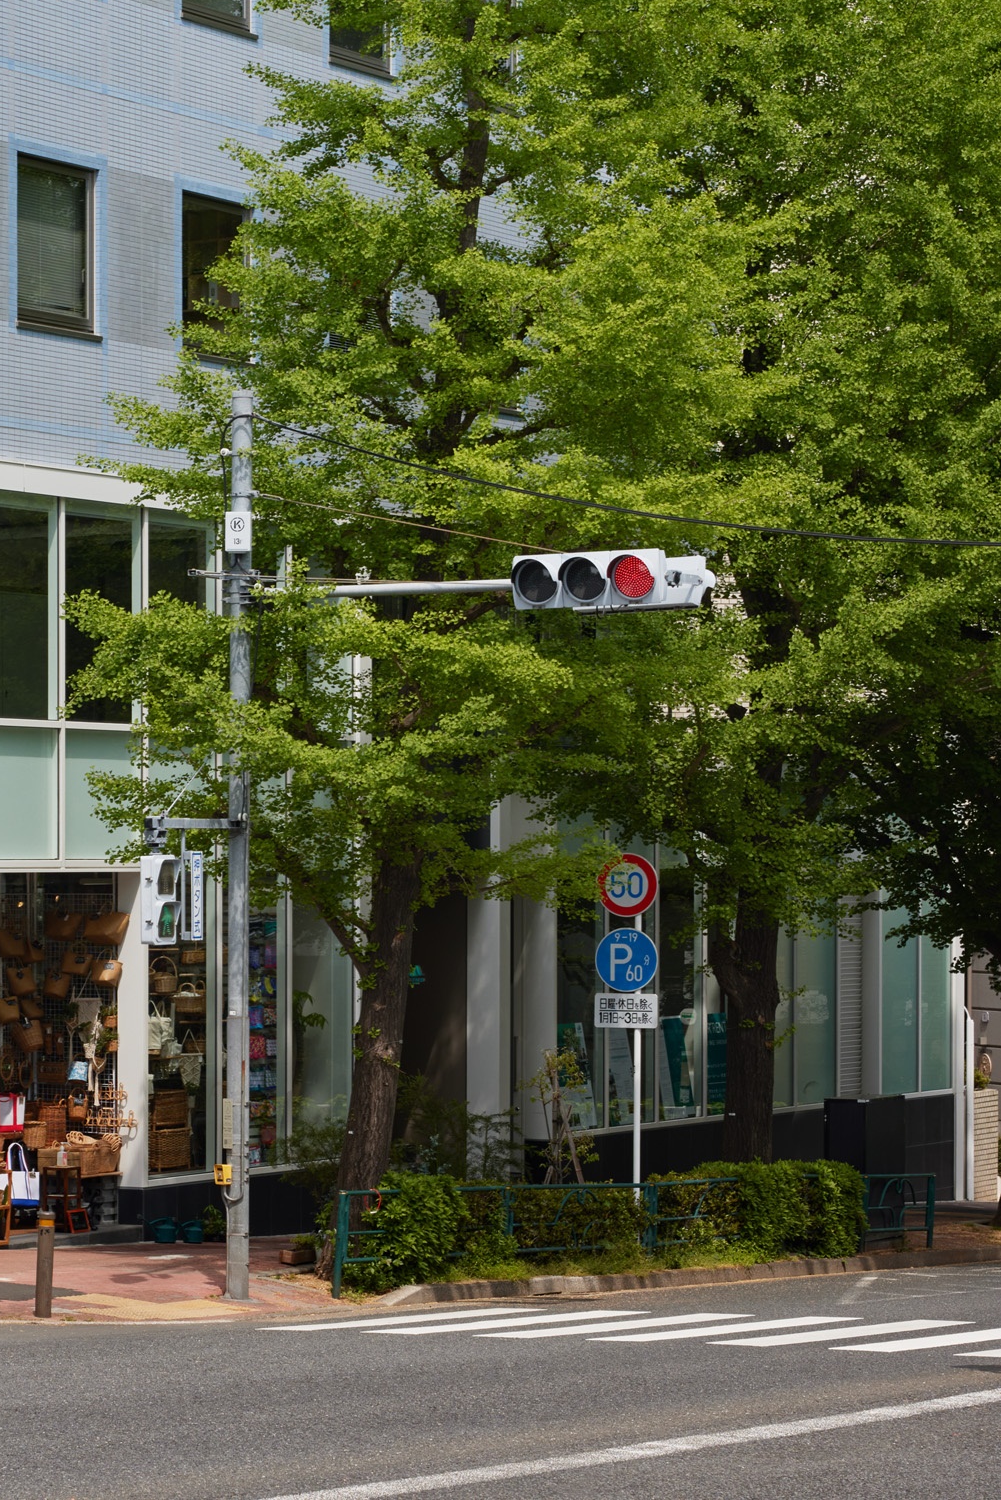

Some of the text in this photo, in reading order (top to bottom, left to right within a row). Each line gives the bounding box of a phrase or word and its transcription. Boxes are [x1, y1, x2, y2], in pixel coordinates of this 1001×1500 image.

[610, 872, 643, 898] 50
[610, 943, 633, 982] P
[625, 954, 650, 982] 60 分
